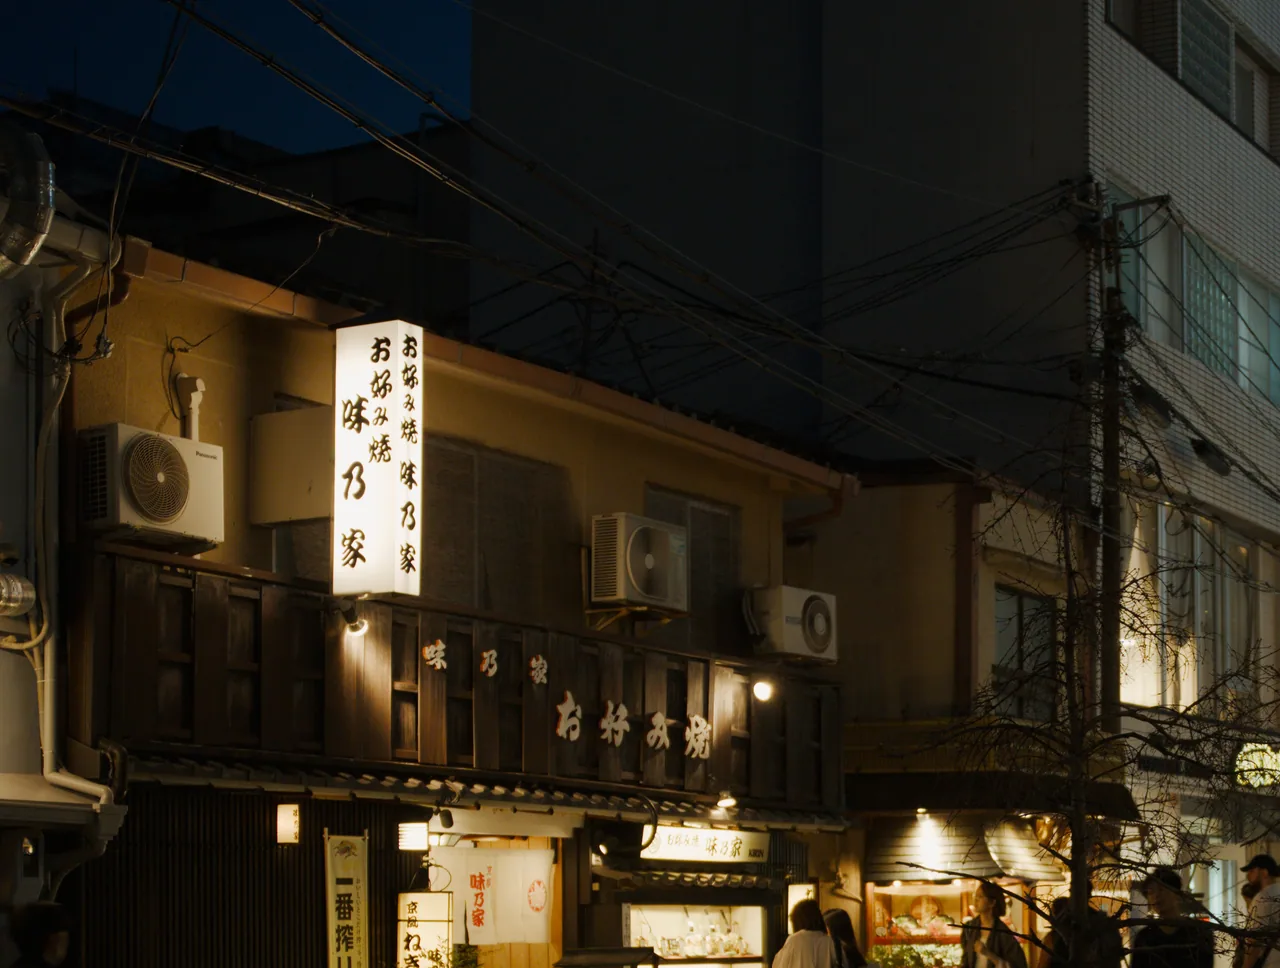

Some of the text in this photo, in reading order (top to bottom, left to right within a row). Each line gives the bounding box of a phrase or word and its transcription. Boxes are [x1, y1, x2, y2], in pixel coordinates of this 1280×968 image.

[368, 336, 393, 464] お好み焼
[341, 393, 370, 568] 味乃家
[556, 690, 713, 760] お好み焼
[470, 872, 486, 928] 味乃家
